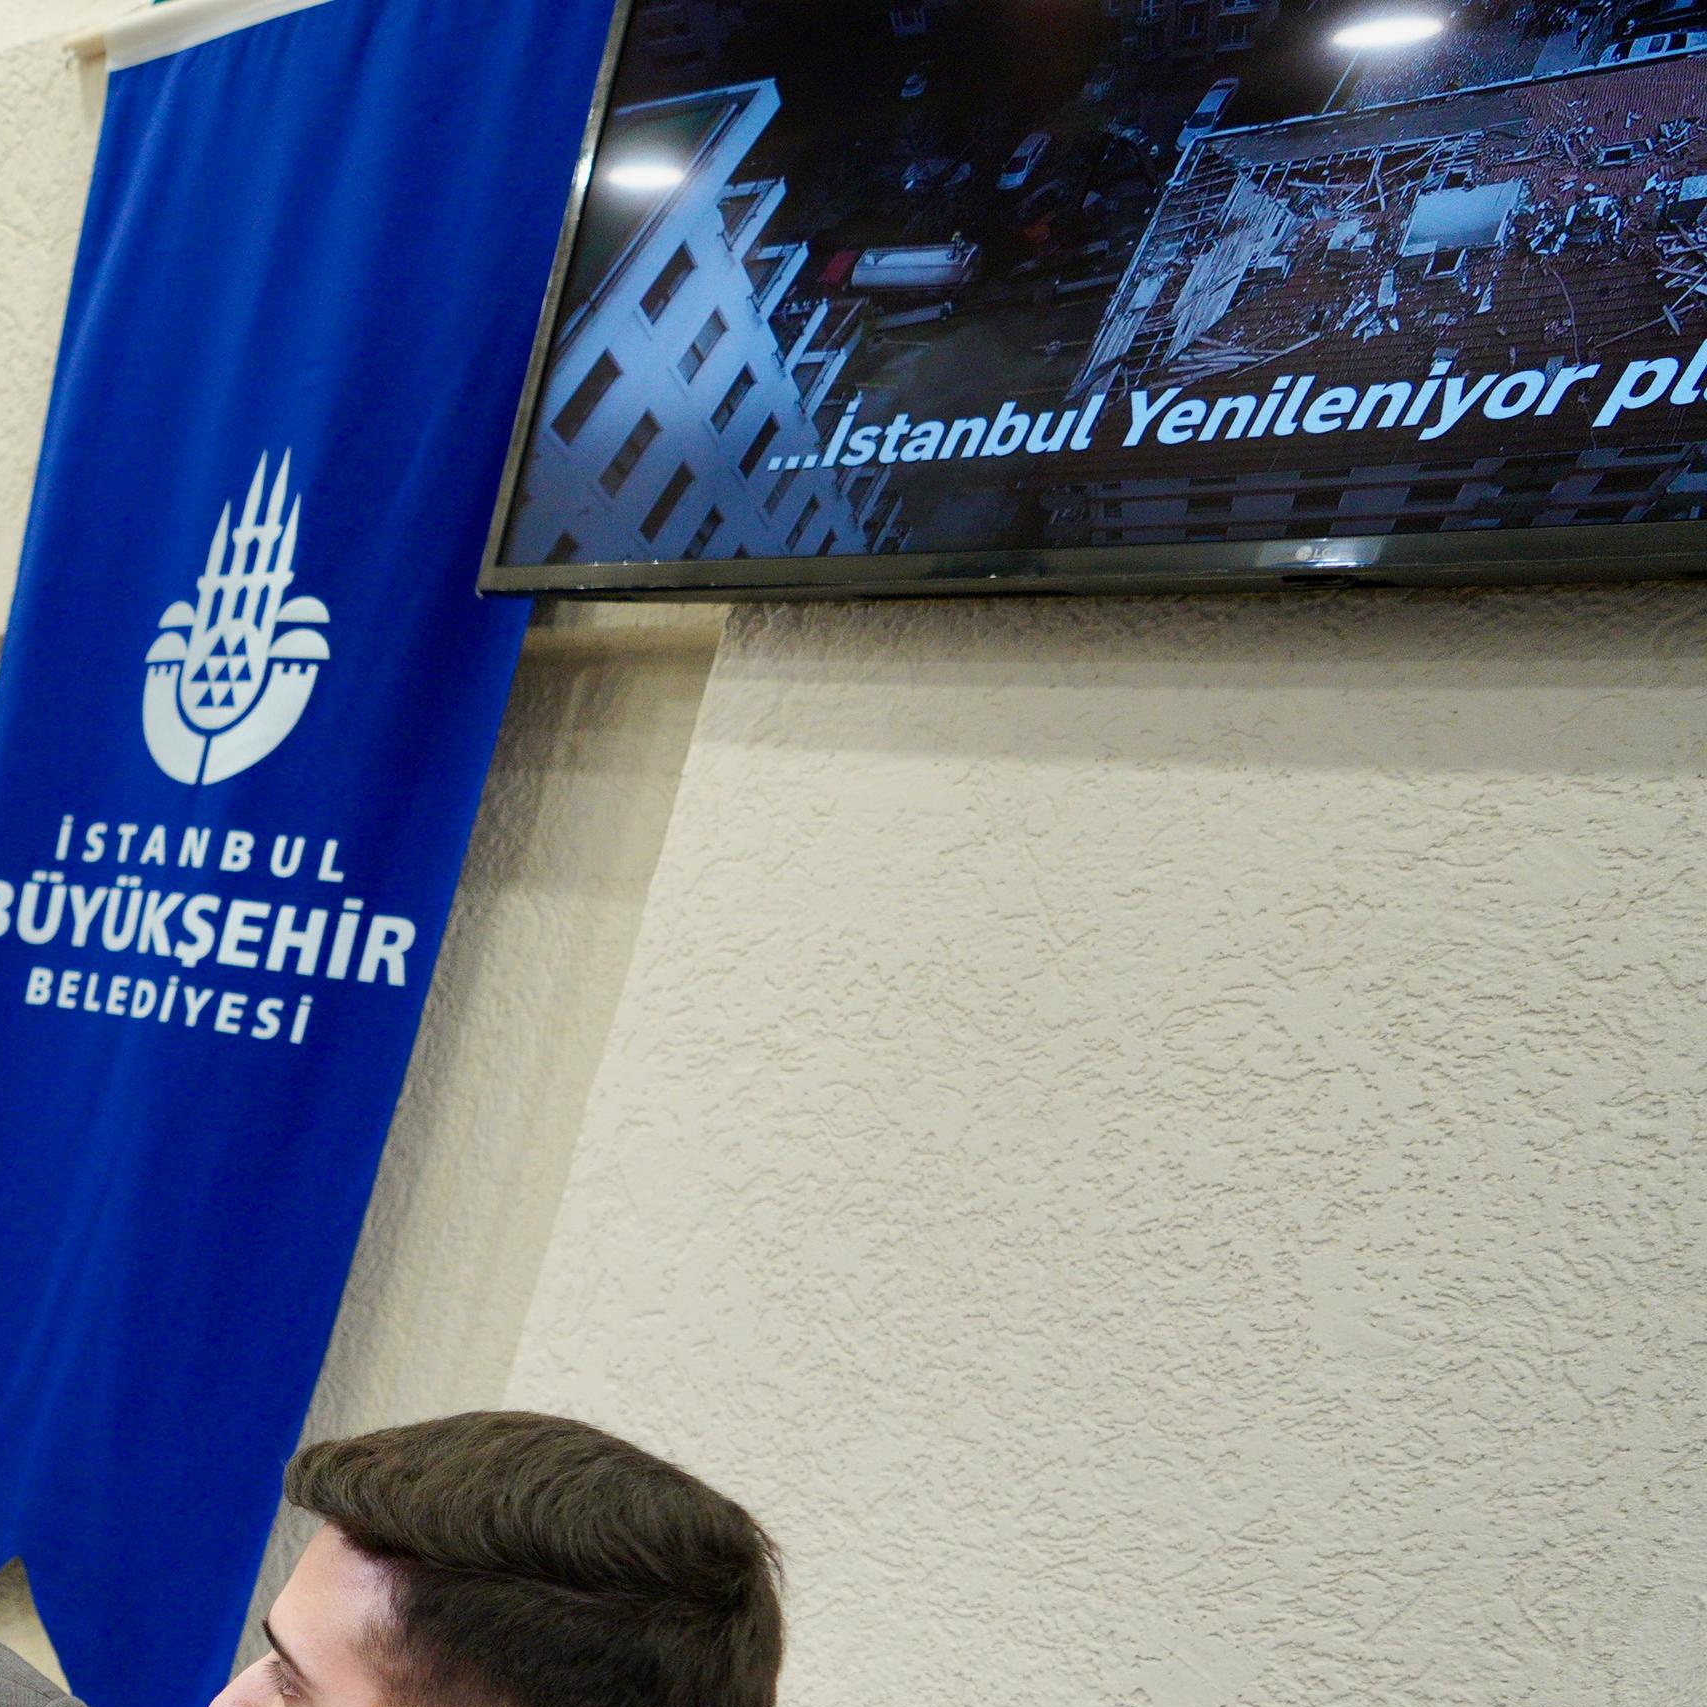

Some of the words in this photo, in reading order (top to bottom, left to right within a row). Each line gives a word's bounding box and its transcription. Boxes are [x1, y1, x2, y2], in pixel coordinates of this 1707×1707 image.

[1116, 356, 1602, 448] Yenileniyor
[1591, 338, 1707, 429] pl
[1313, 547, 1332, 559] LG
[55, 814, 346, 883] İSTANBUL
[24, 965, 314, 1045] BELEDİYESİ
